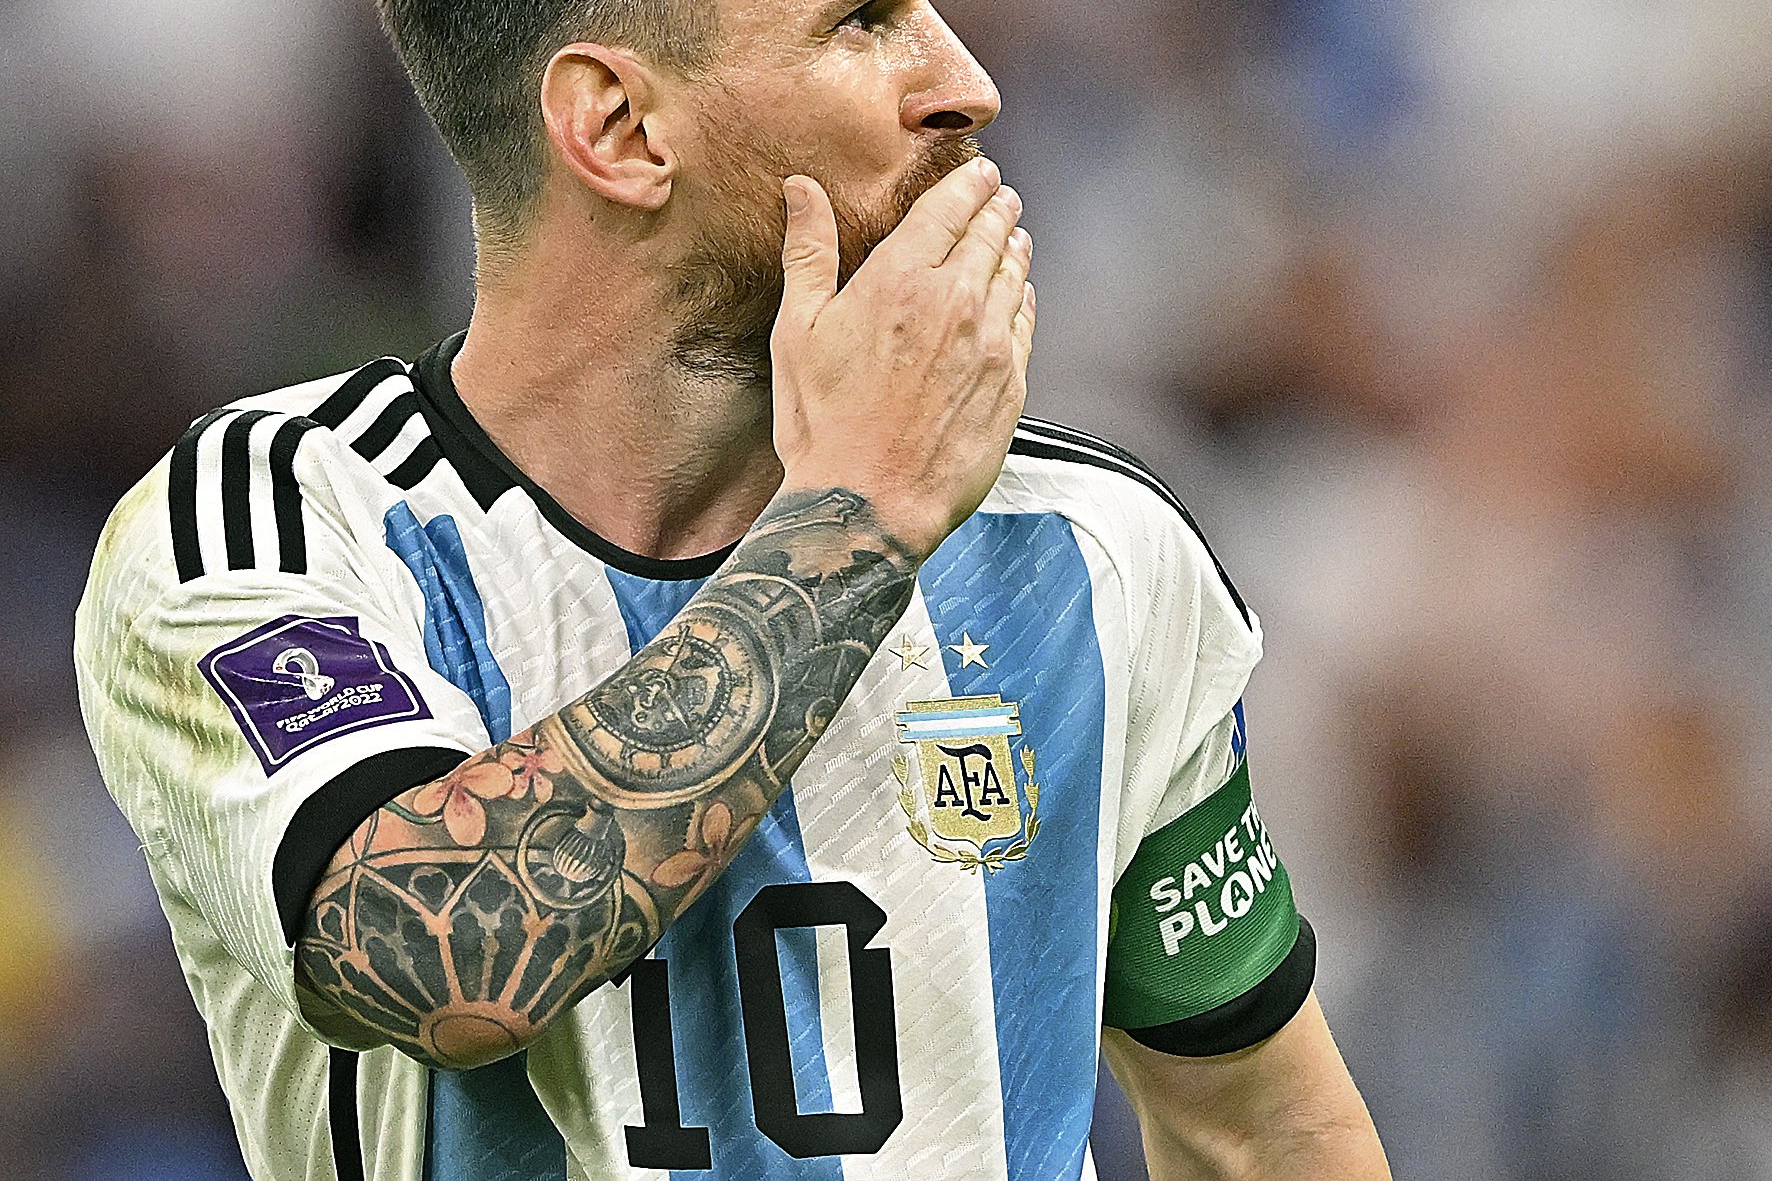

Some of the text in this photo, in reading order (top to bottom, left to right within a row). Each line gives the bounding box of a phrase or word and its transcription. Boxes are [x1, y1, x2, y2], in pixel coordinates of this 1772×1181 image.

[306, 687, 356, 715] WORLD
[356, 683, 384, 694] CUP
[934, 743, 1010, 821] AFA
[1149, 826, 1245, 913] SAVE
[1158, 818, 1277, 956] PLANE
[609, 880, 904, 1171] 10
